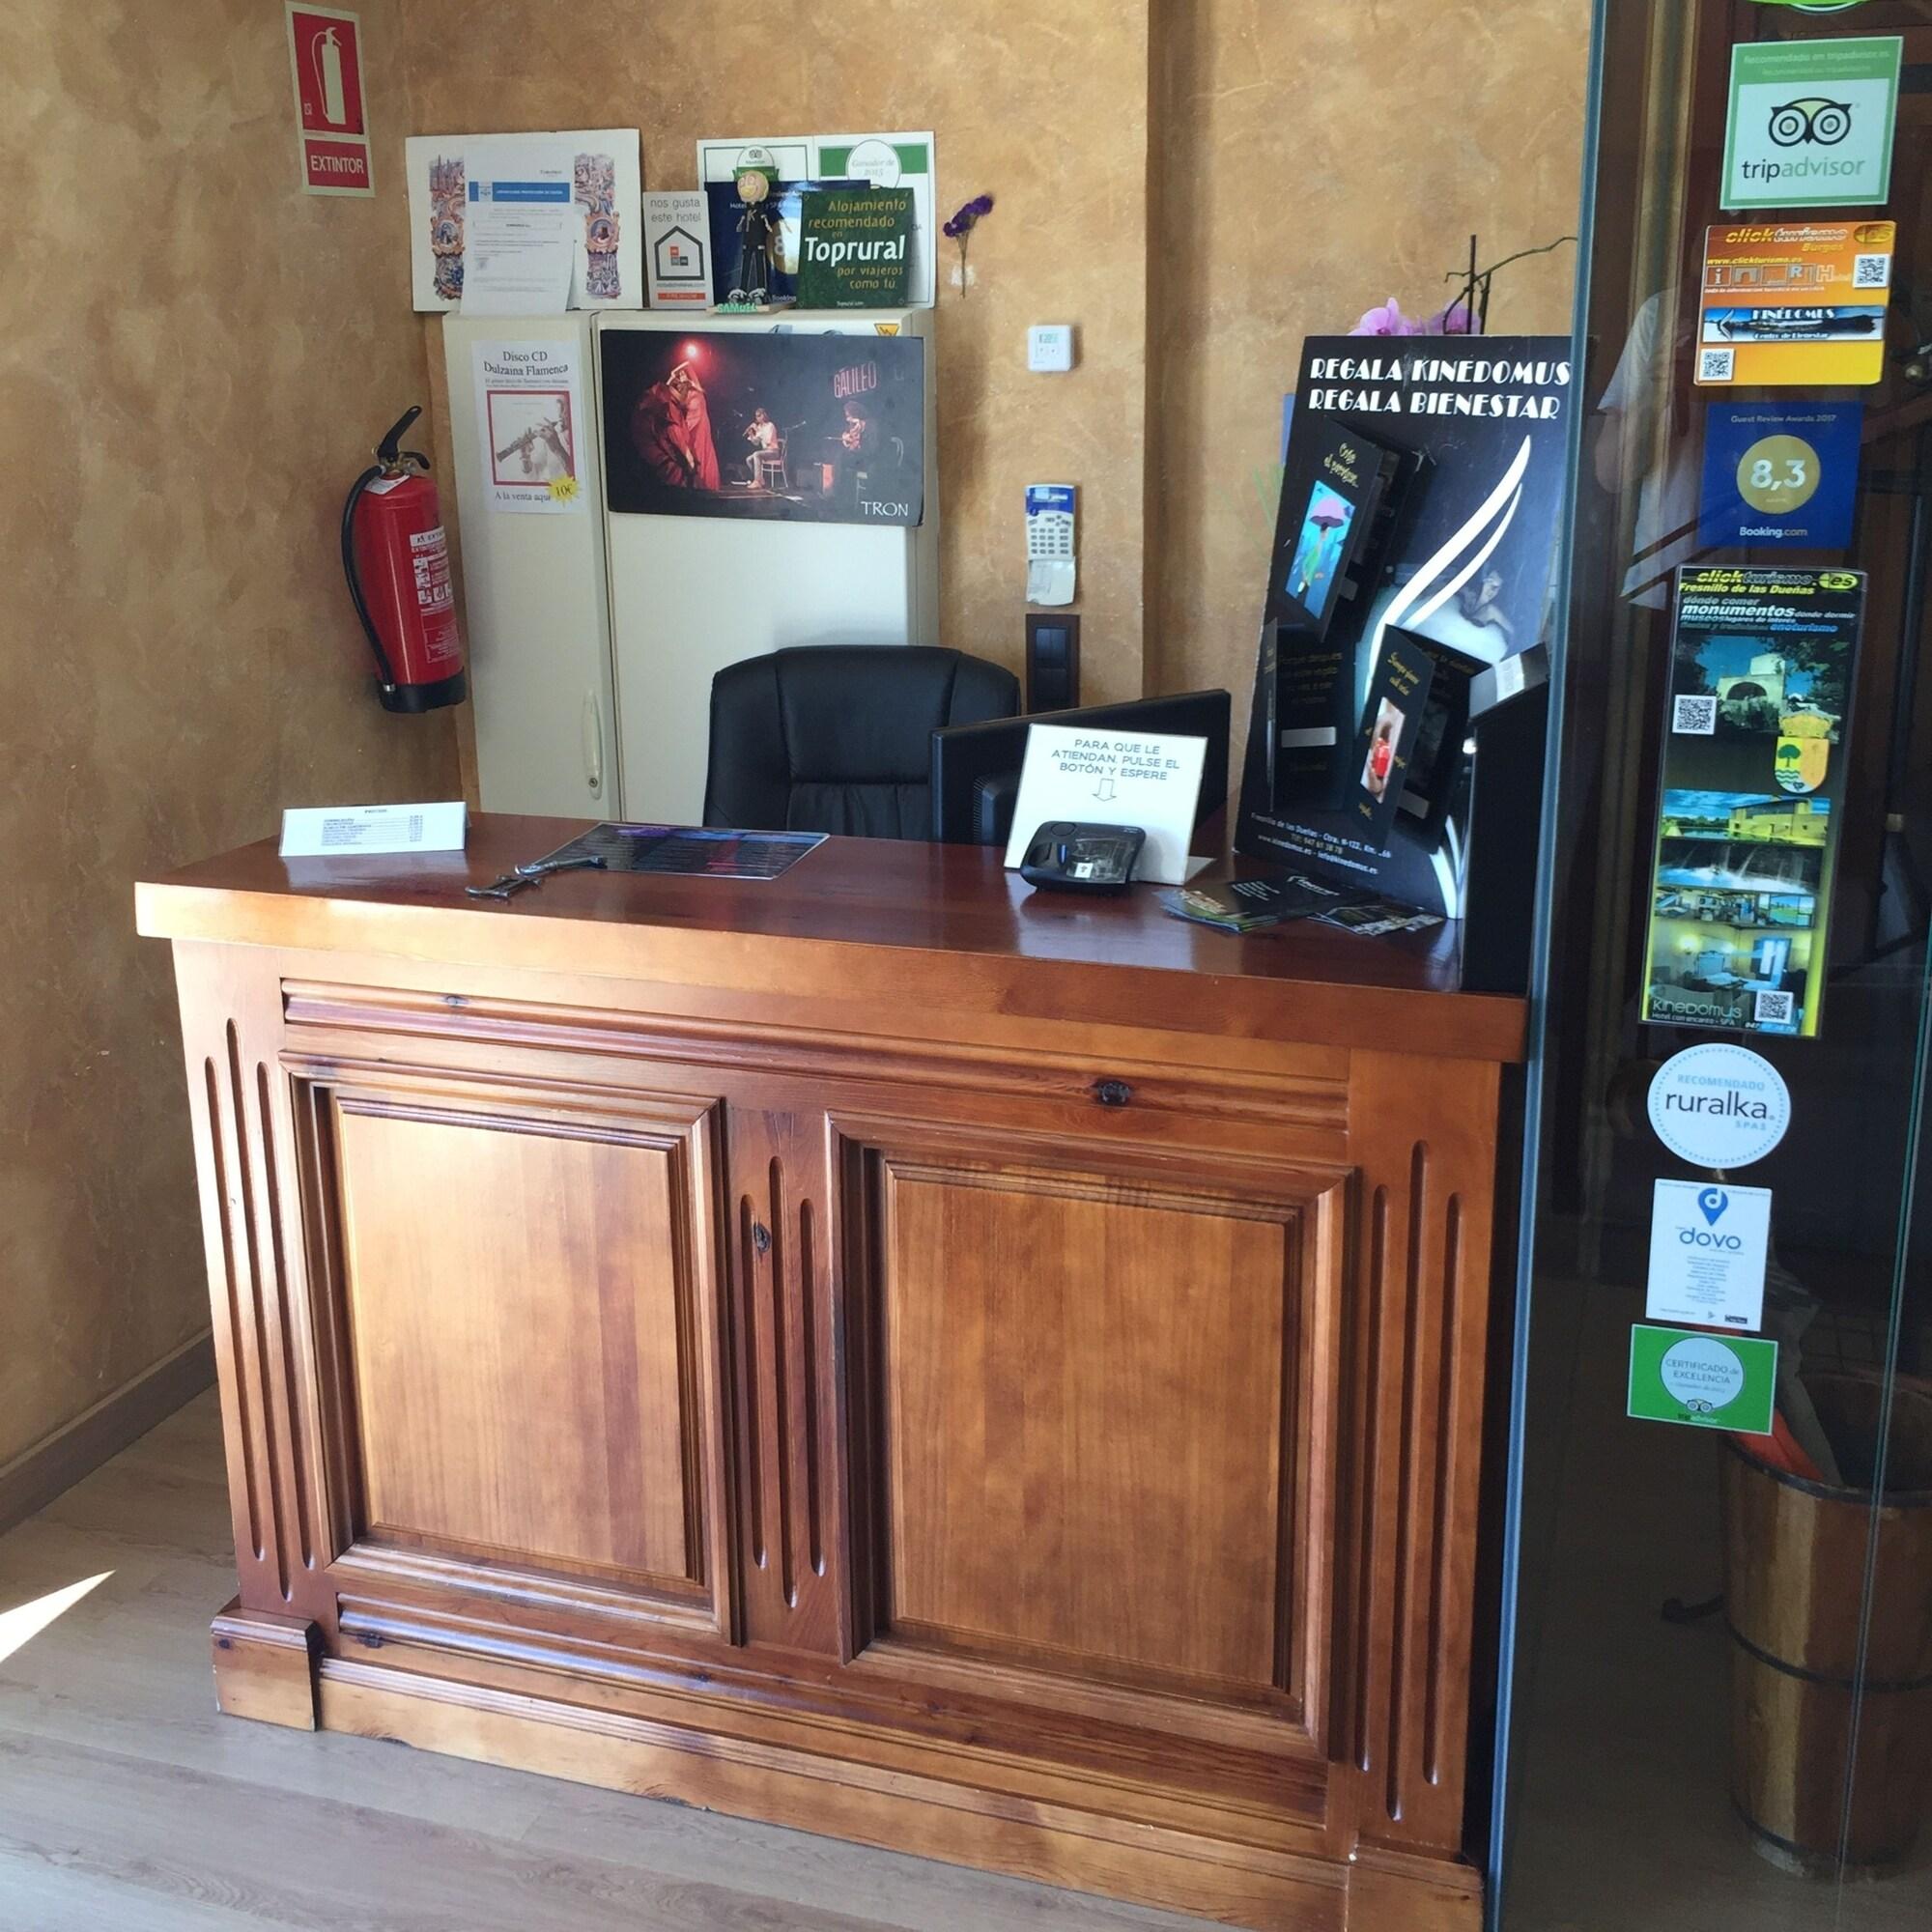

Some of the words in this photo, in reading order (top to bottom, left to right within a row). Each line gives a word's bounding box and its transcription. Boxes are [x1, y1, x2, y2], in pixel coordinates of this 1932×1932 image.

[310, 155, 364, 174] EXTINTOR
[1741, 156, 1866, 183] tripadvisor
[650, 199, 669, 208] nos
[672, 198, 701, 210] gusta
[828, 199, 907, 214] Alojamiento
[651, 213, 672, 223] este
[676, 213, 702, 223] hotel
[808, 215, 895, 229] recomendado
[804, 234, 906, 268] Toprural
[1801, 242, 1845, 253] Burgos
[837, 266, 856, 277] por
[860, 266, 903, 277] viajeros
[849, 278, 880, 290] como
[883, 278, 897, 289] tú
[502, 351, 529, 362] Disco
[530, 351, 549, 362] CD
[483, 360, 525, 376] Dulzaina
[526, 362, 569, 377] Flamenca
[1309, 357, 1404, 382] REGALA
[1410, 358, 1573, 386] KINEDOMUS
[1307, 388, 1402, 413] REGALA
[1408, 391, 1562, 420] BIENESTAR
[1730, 414, 1755, 423] Guest
[1756, 414, 1784, 423] Review
[1749, 459, 1806, 492] 8,3
[511, 492, 532, 501] venta
[860, 500, 909, 518] TRON
[1739, 526, 1809, 539] Booking.com
[1678, 582, 1729, 593] Fresnillo
[1730, 582, 1747, 593] de
[1747, 583, 1768, 594] las
[1769, 584, 1816, 596] Dueñas
[1720, 597, 1761, 606] comer
[1681, 604, 1796, 618] monumentos
[1074, 738, 1110, 751] PARA
[1113, 741, 1143, 754] QUE
[1145, 744, 1161, 755] LE
[1122, 754, 1161, 768] PULSE
[1165, 758, 1180, 770] EL
[1059, 759, 1104, 775] BOTÓN
[1107, 766, 1117, 776] Y
[1120, 768, 1169, 781] ESPERE
[1677, 1074, 1766, 1092] RECOMENDADO
[1664, 1091, 1768, 1121] ruralka
[1735, 1121, 1768, 1131] SPAS
[1679, 1227, 1742, 1250] dovo
[1664, 1358, 1729, 1374] CERTIFICADO
[1672, 1370, 1731, 1384] EXCELENCIA
